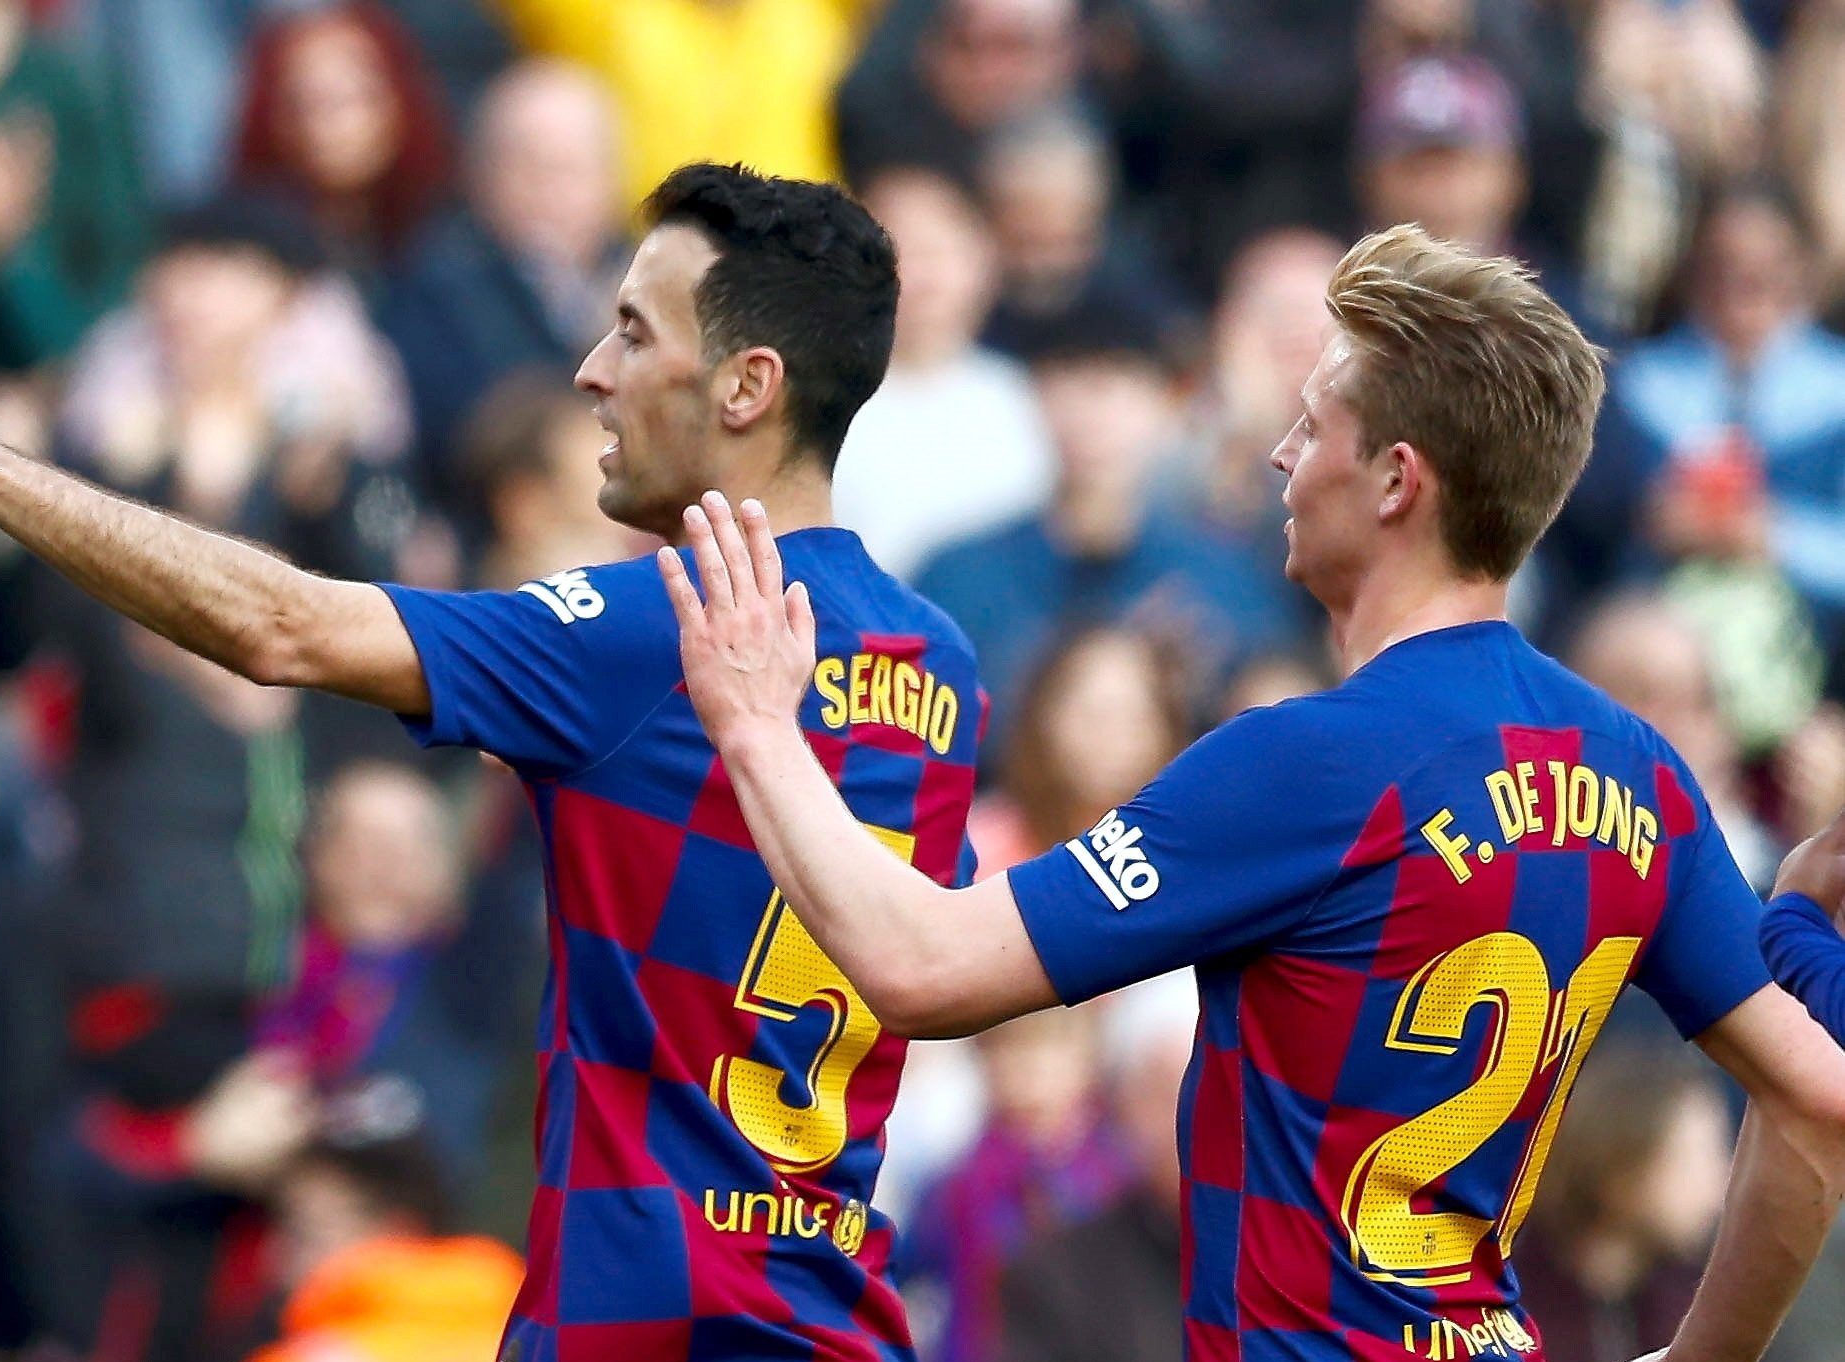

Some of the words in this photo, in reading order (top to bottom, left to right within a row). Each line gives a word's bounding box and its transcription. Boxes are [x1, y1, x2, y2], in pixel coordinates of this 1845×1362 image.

[813, 653, 959, 755] SERGIO
[1420, 807, 1495, 885] F.
[1484, 761, 1544, 845] DE
[1547, 760, 1659, 881] JONG
[708, 823, 916, 1174] 5
[1339, 931, 1643, 1287] 21
[704, 1180, 834, 1239] unic
